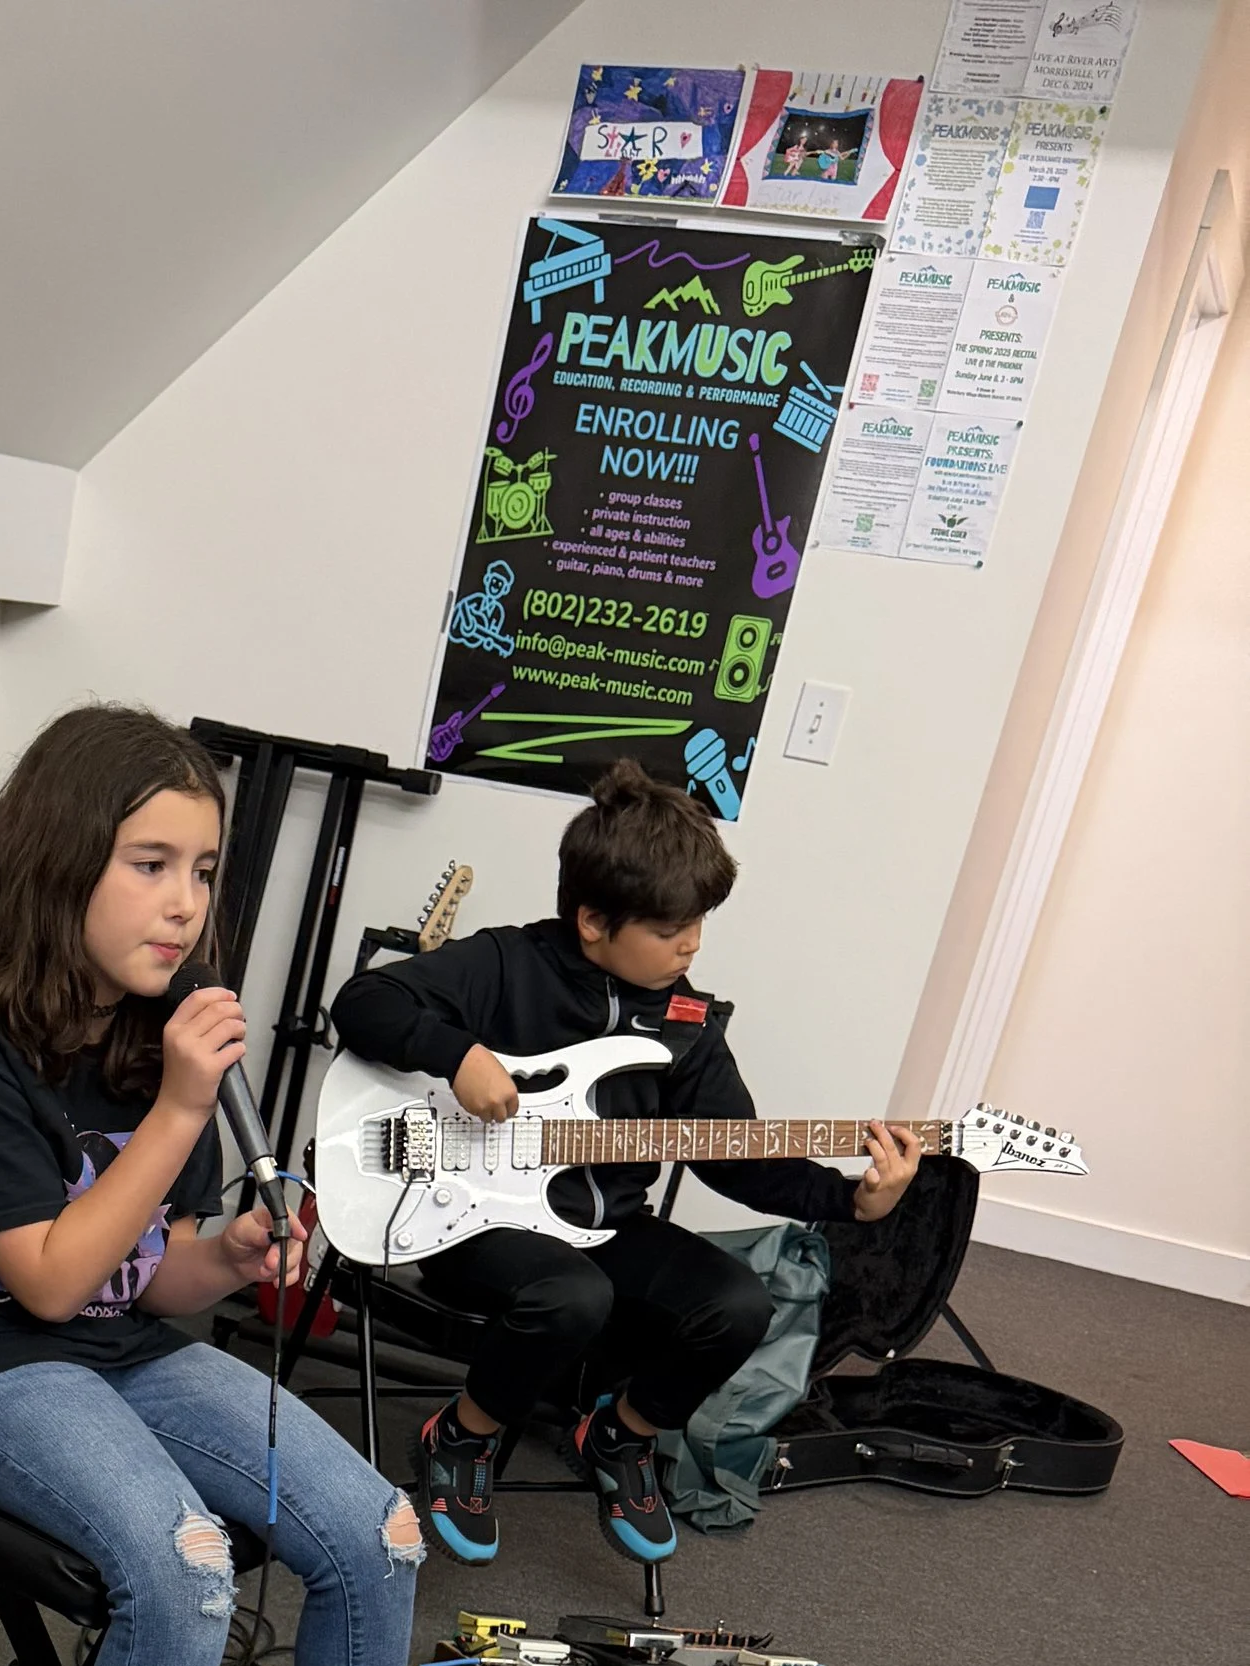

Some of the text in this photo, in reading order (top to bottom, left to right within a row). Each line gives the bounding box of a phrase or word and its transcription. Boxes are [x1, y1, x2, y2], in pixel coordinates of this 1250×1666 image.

[1033, 52, 1051, 62] LIVE
[1067, 55, 1094, 66] RIVER
[1095, 57, 1117, 67] ARTS
[1097, 69, 1109, 79] VT
[932, 124, 999, 141] PEAKMUSIC
[1025, 122, 1093, 140] PEAKMUSIC
[900, 271, 953, 286] PEAKMUSIC
[987, 278, 1041, 293] PEAKMUSIC
[979, 329, 1023, 343] PRESENTS:
[556, 312, 792, 387] PEAKMUSIC
[955, 343, 1038, 359] THE SPRING 2025 RECITAL
[985, 360, 996, 368] THE
[955, 370, 977, 381] Sunday
[978, 373, 992, 382] June
[553, 371, 780, 408] EDUCATION, RECORDING & PERFORMANCE
[575, 403, 740, 450] ENROLLING
[862, 422, 913, 437] PEAKMUSIC
[946, 431, 1000, 446] PEAKMUSIC
[600, 445, 700, 484] NOW!!!
[608, 490, 682, 510] group classes
[592, 507, 691, 530] private instruction
[589, 525, 686, 548] all ages & abilities
[552, 540, 716, 571] experienced & patient teachers
[556, 558, 704, 588] guitar, piano, drums & more
[523, 588, 708, 639] (802)232-2619
[516, 629, 705, 676] info@peak-music.com
[512, 665, 693, 706] www.peak-music.com
[1001, 1141, 1046, 1167] Ibanez
